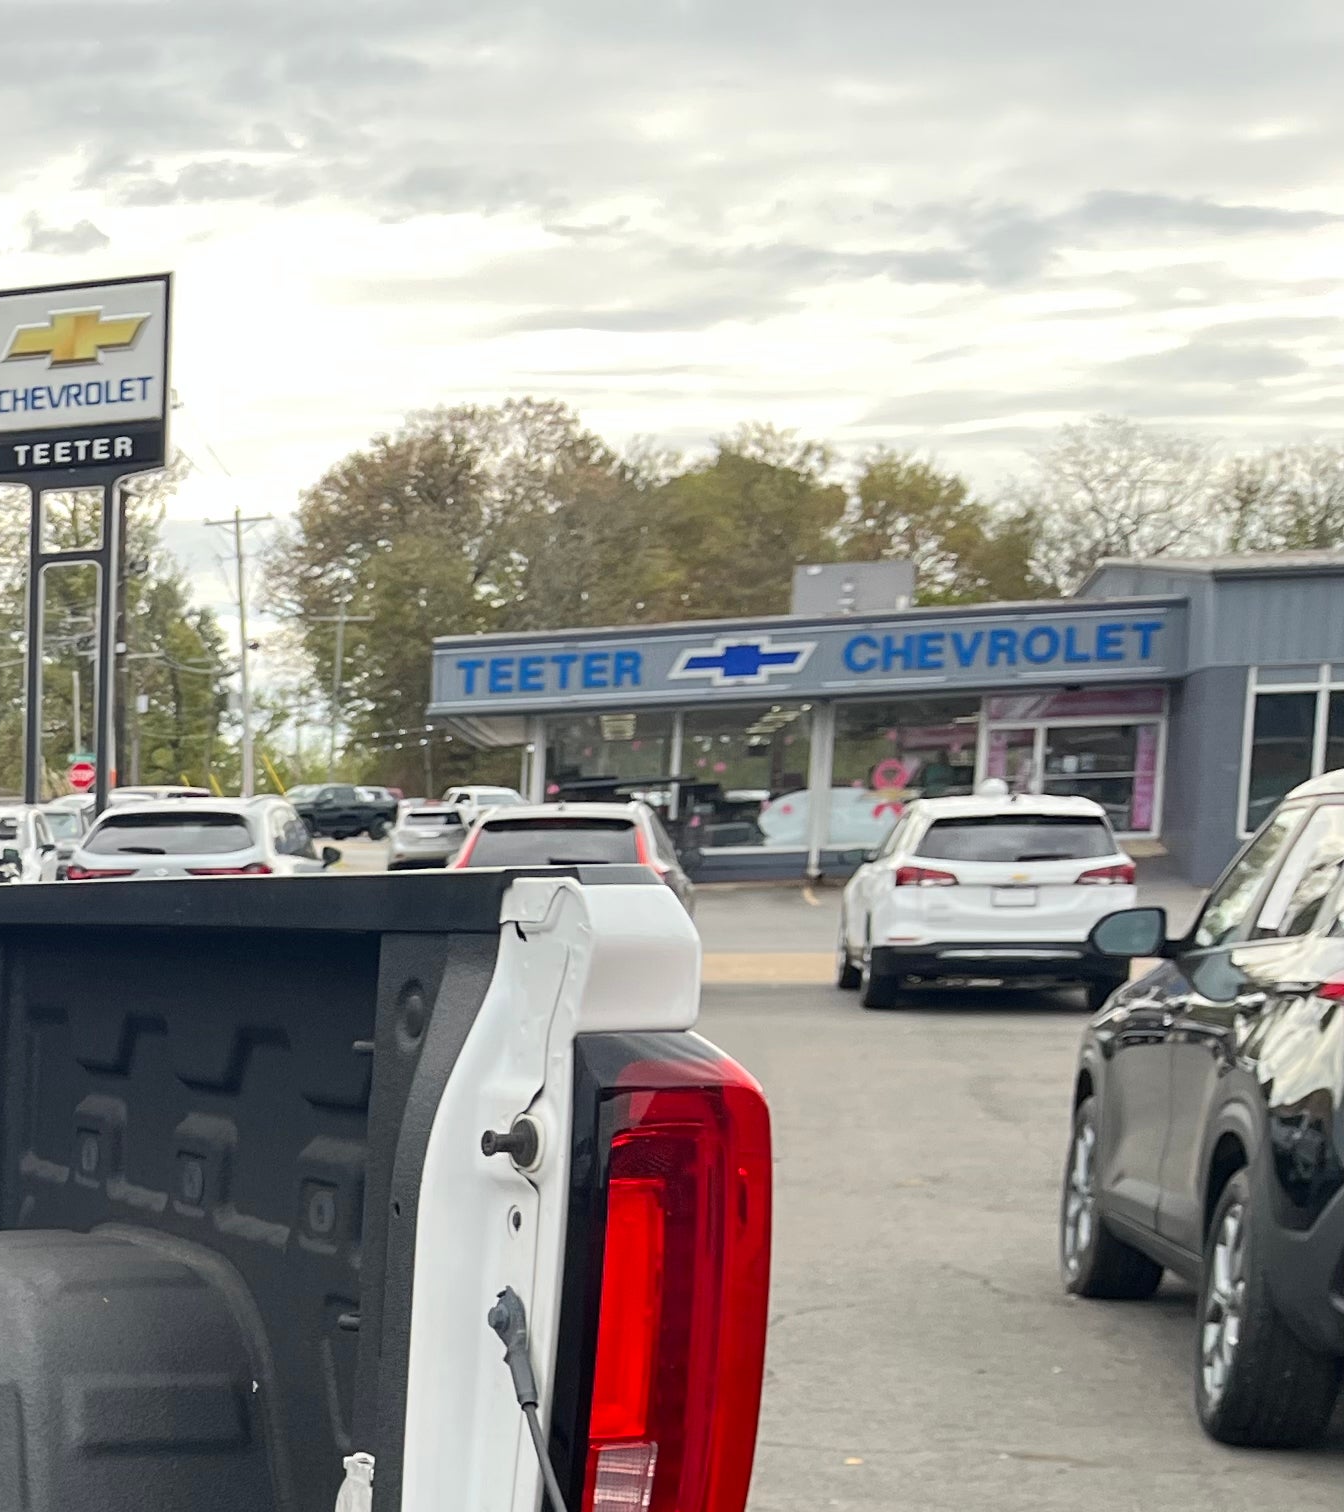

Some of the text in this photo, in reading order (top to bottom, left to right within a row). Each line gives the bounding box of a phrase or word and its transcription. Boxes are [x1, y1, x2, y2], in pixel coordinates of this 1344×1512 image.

[13, 436, 134, 466] TEETER
[456, 621, 1163, 695] TEETER CHEVROLET
